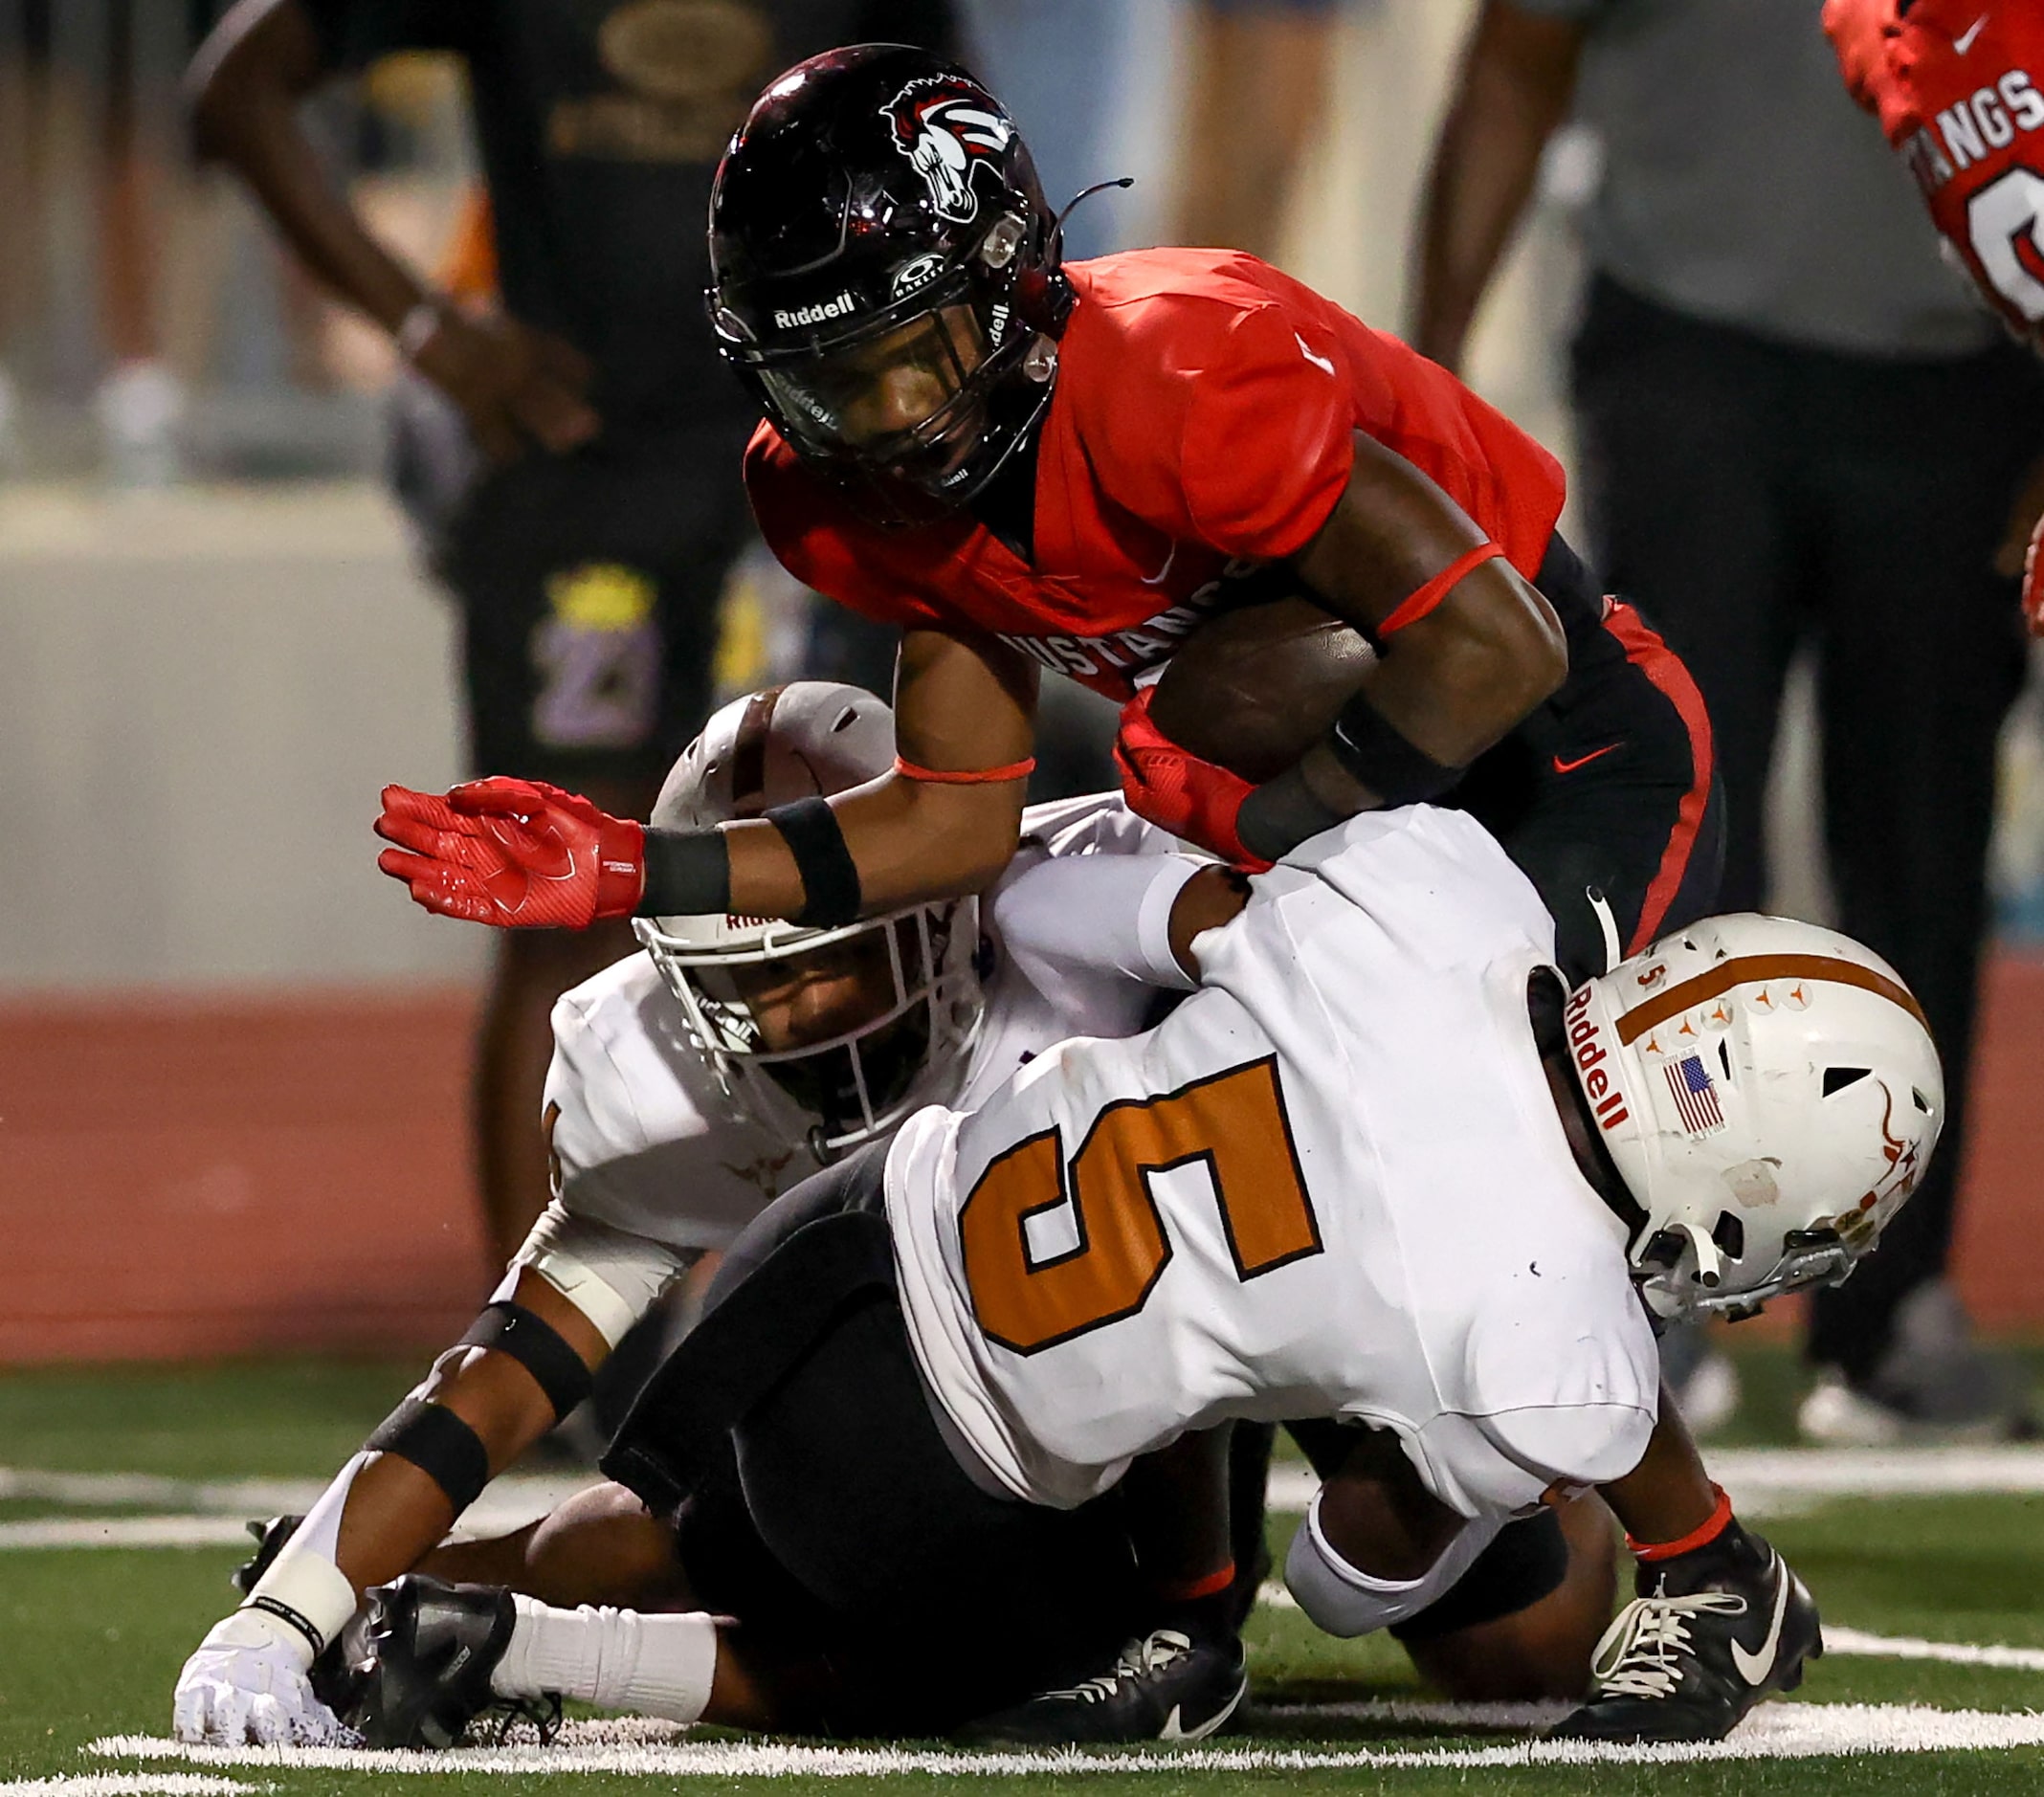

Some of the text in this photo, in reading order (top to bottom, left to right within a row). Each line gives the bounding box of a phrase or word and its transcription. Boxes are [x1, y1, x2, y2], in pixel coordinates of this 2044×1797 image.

[774, 292, 855, 329] Riddell
[1637, 965, 1667, 987] 5
[1566, 986, 1630, 1131] Riddell
[957, 1052, 1324, 1358] 5
